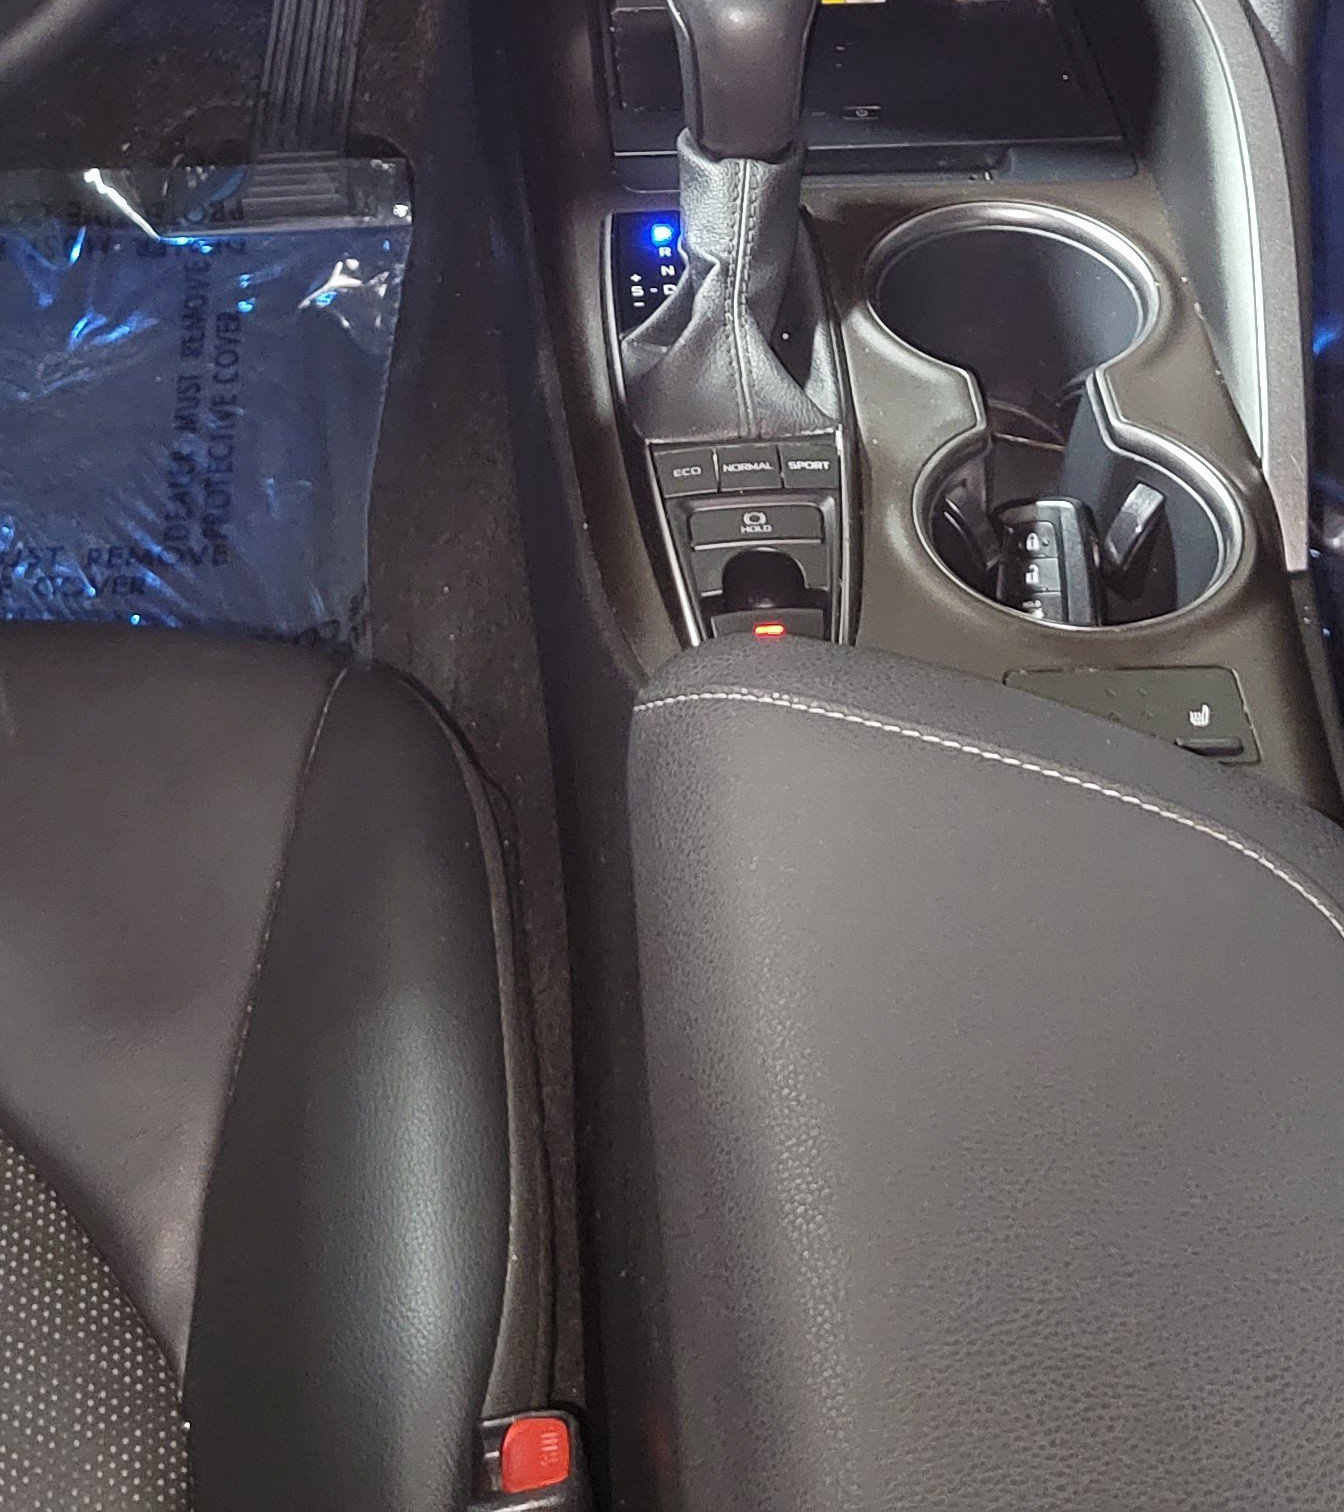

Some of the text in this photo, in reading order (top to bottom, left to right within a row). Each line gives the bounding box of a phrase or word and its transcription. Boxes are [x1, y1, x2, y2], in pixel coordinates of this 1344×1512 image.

[658, 246, 672, 258] R
[660, 265, 676, 277] N
[630, 285, 645, 297] S
[212, 310, 243, 385] COVER
[174, 374, 202, 433] MUST
[673, 465, 703, 478] ECO
[722, 460, 775, 473] NORMAL
[787, 460, 832, 472] SPORT
[740, 524, 774, 535] HOLD
